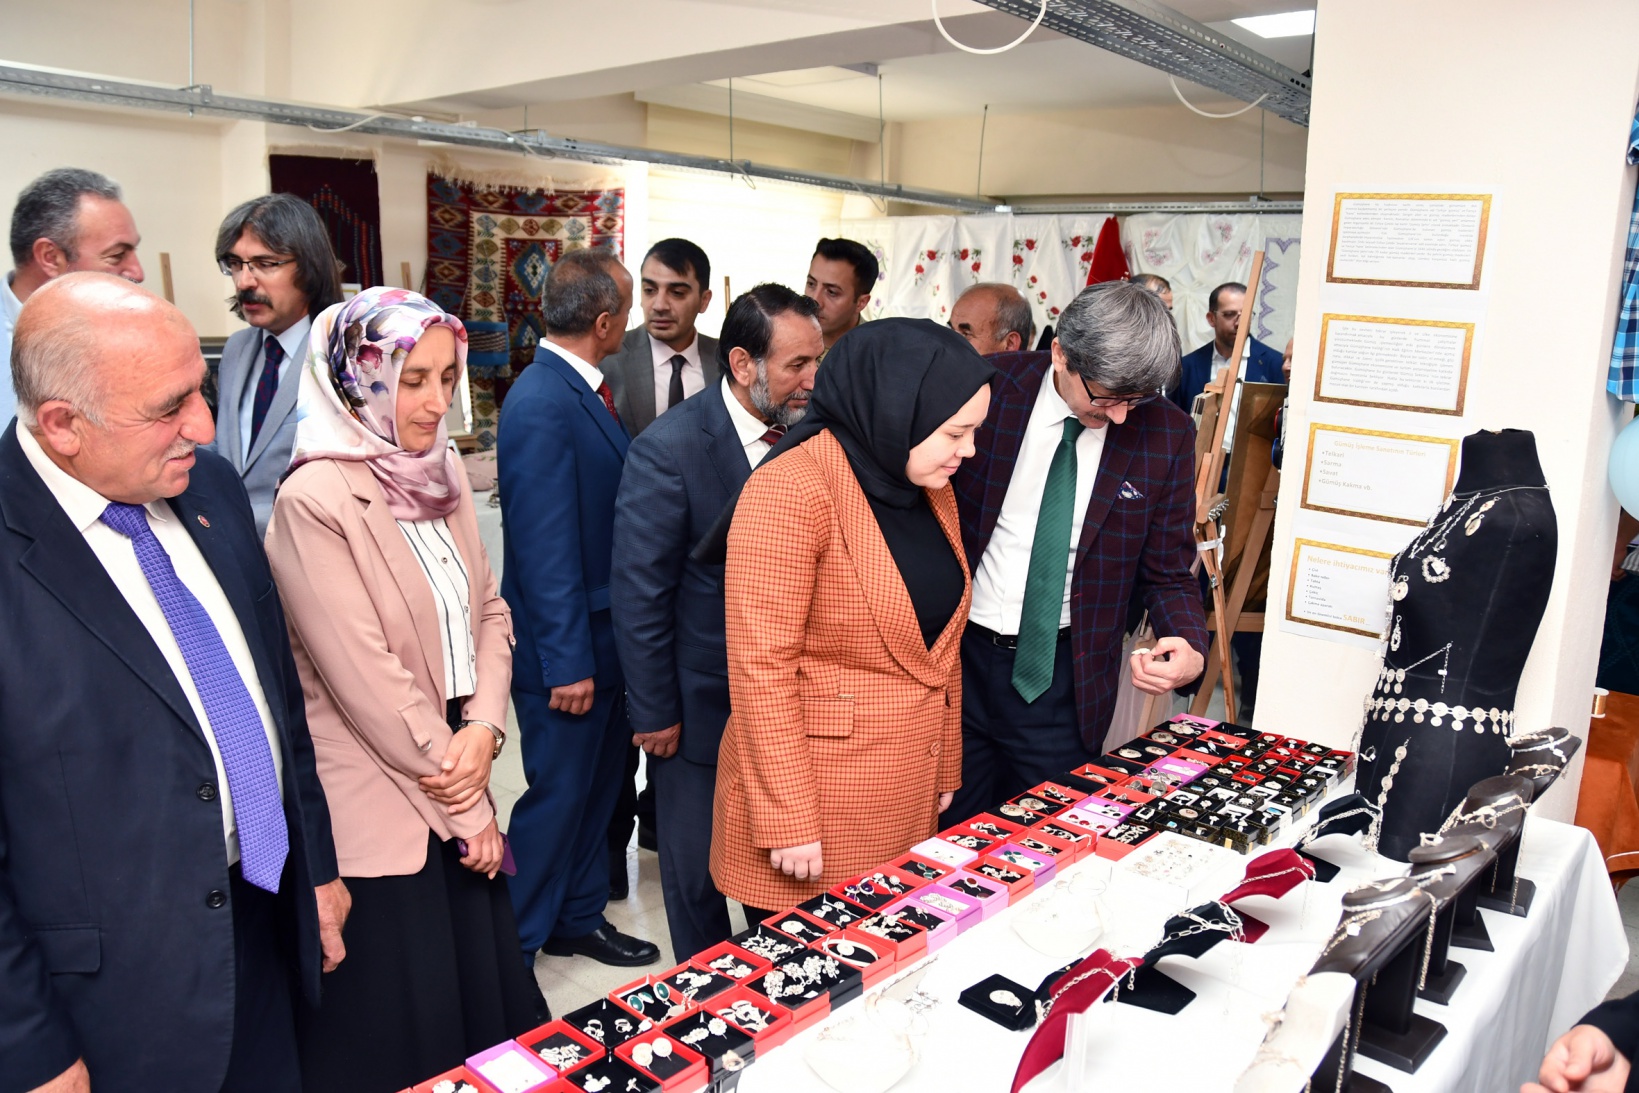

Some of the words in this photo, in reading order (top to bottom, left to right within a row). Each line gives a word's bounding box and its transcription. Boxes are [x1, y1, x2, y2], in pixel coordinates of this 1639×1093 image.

[1376, 444, 1404, 454] Sanatının
[1406, 448, 1426, 456] Türleri
[1322, 478, 1341, 487] Gümüş
[1342, 482, 1362, 490] Kakma
[1308, 555, 1332, 566] Nelere
[1333, 560, 1374, 574] ihtiyacımız
